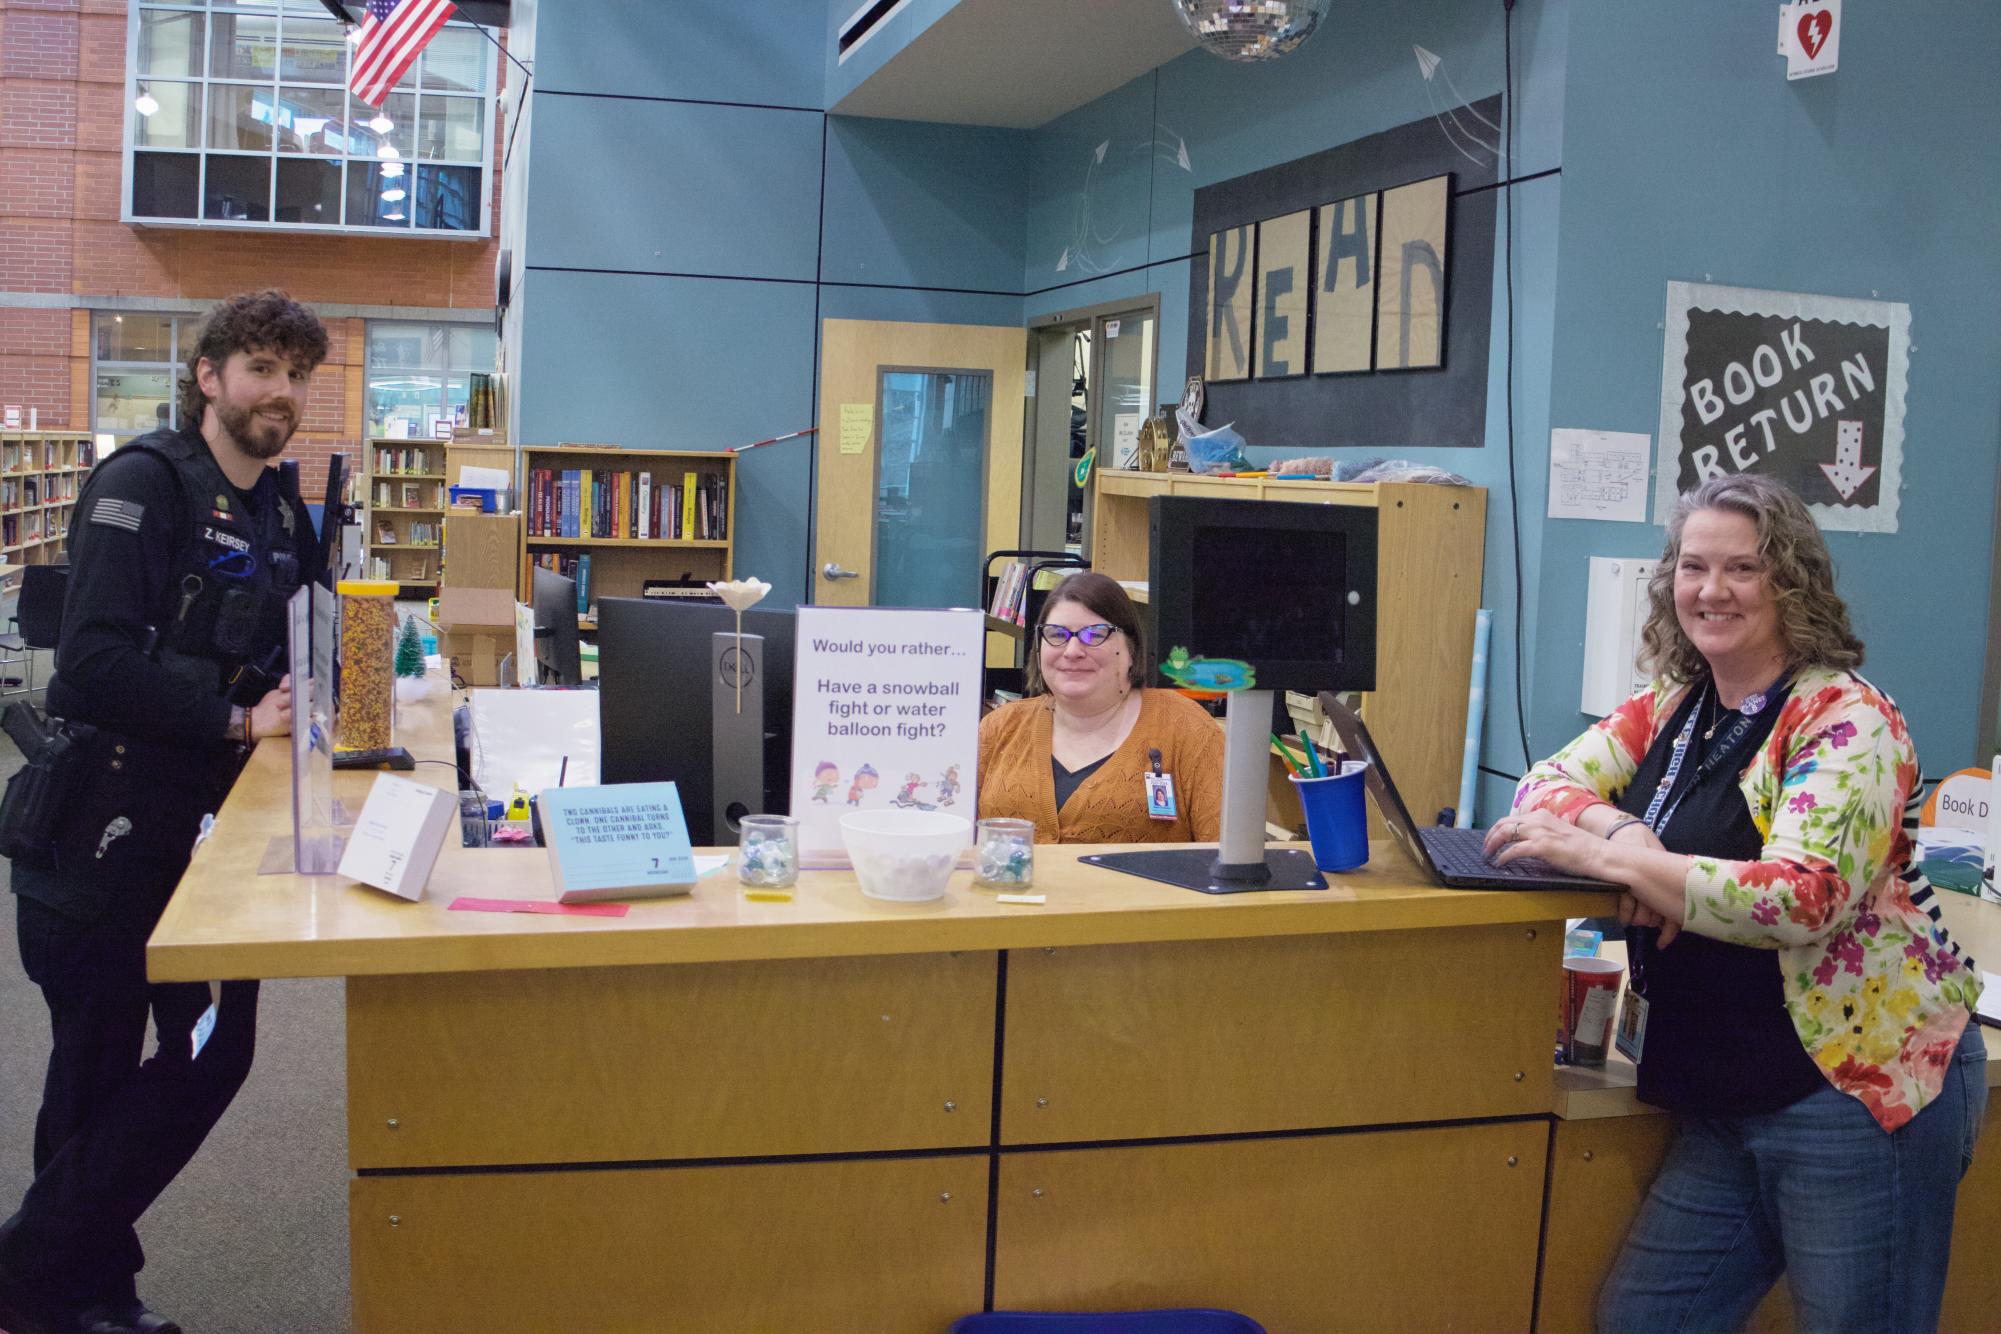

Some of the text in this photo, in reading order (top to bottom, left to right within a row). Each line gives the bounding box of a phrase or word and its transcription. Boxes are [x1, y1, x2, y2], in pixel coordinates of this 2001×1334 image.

[1690, 323, 1815, 425] BOOK
[1692, 353, 1875, 482] RETURN
[215, 531, 250, 553] KEIRSEY
[813, 638, 863, 653] Would
[867, 643, 897, 657] you
[817, 678, 960, 696] Have a snowball
[828, 700, 947, 718] fight or water
[828, 722, 946, 740] balloon fight?
[562, 803, 669, 816] TWO CANNIBALS ARE EATING A
[1942, 794, 1974, 816] Book
[594, 816, 608, 825] ONE
[609, 814, 645, 824] CANNIBAL
[646, 812, 670, 821] TURNS
[575, 826, 586, 835] TO
[587, 825, 600, 834] THE
[602, 824, 625, 833] OTHER
[627, 823, 642, 832] AND
[593, 834, 615, 842] TASTE
[616, 833, 640, 841] FUNNY
[641, 832, 651, 841] TO
[651, 856, 660, 869] 7
